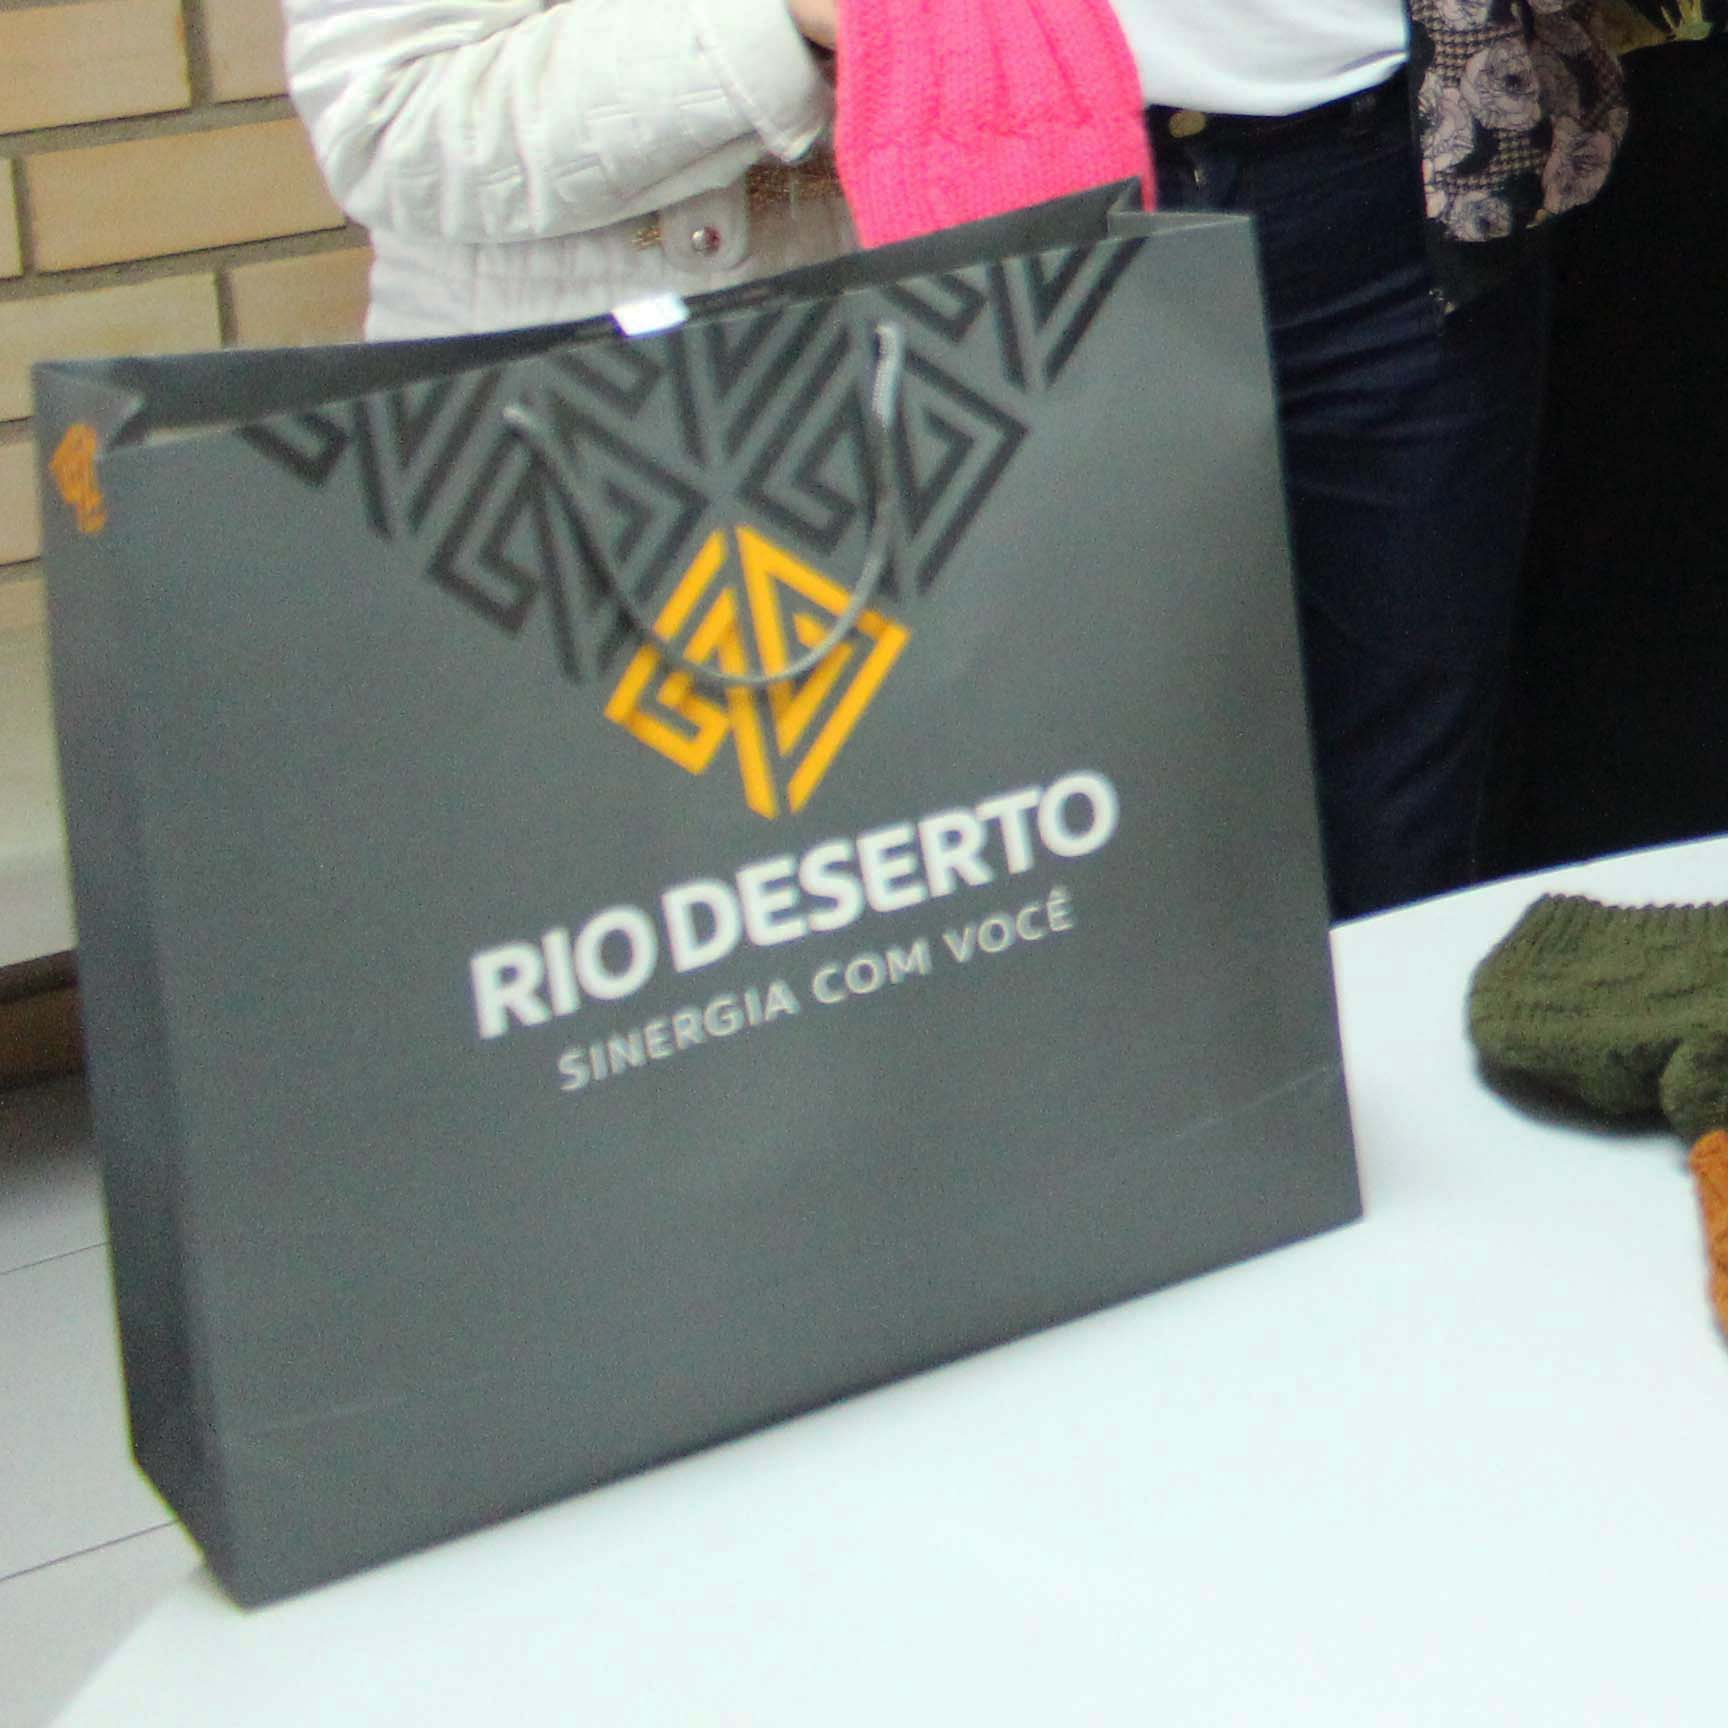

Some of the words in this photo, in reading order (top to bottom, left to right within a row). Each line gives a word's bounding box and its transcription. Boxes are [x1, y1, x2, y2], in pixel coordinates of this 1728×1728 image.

[470, 903, 659, 1040] RIO
[661, 769, 1121, 972] DESERTO
[557, 979, 800, 1091] SINERGIA
[812, 936, 934, 1005] COM
[942, 884, 1076, 964] VOCÊ
